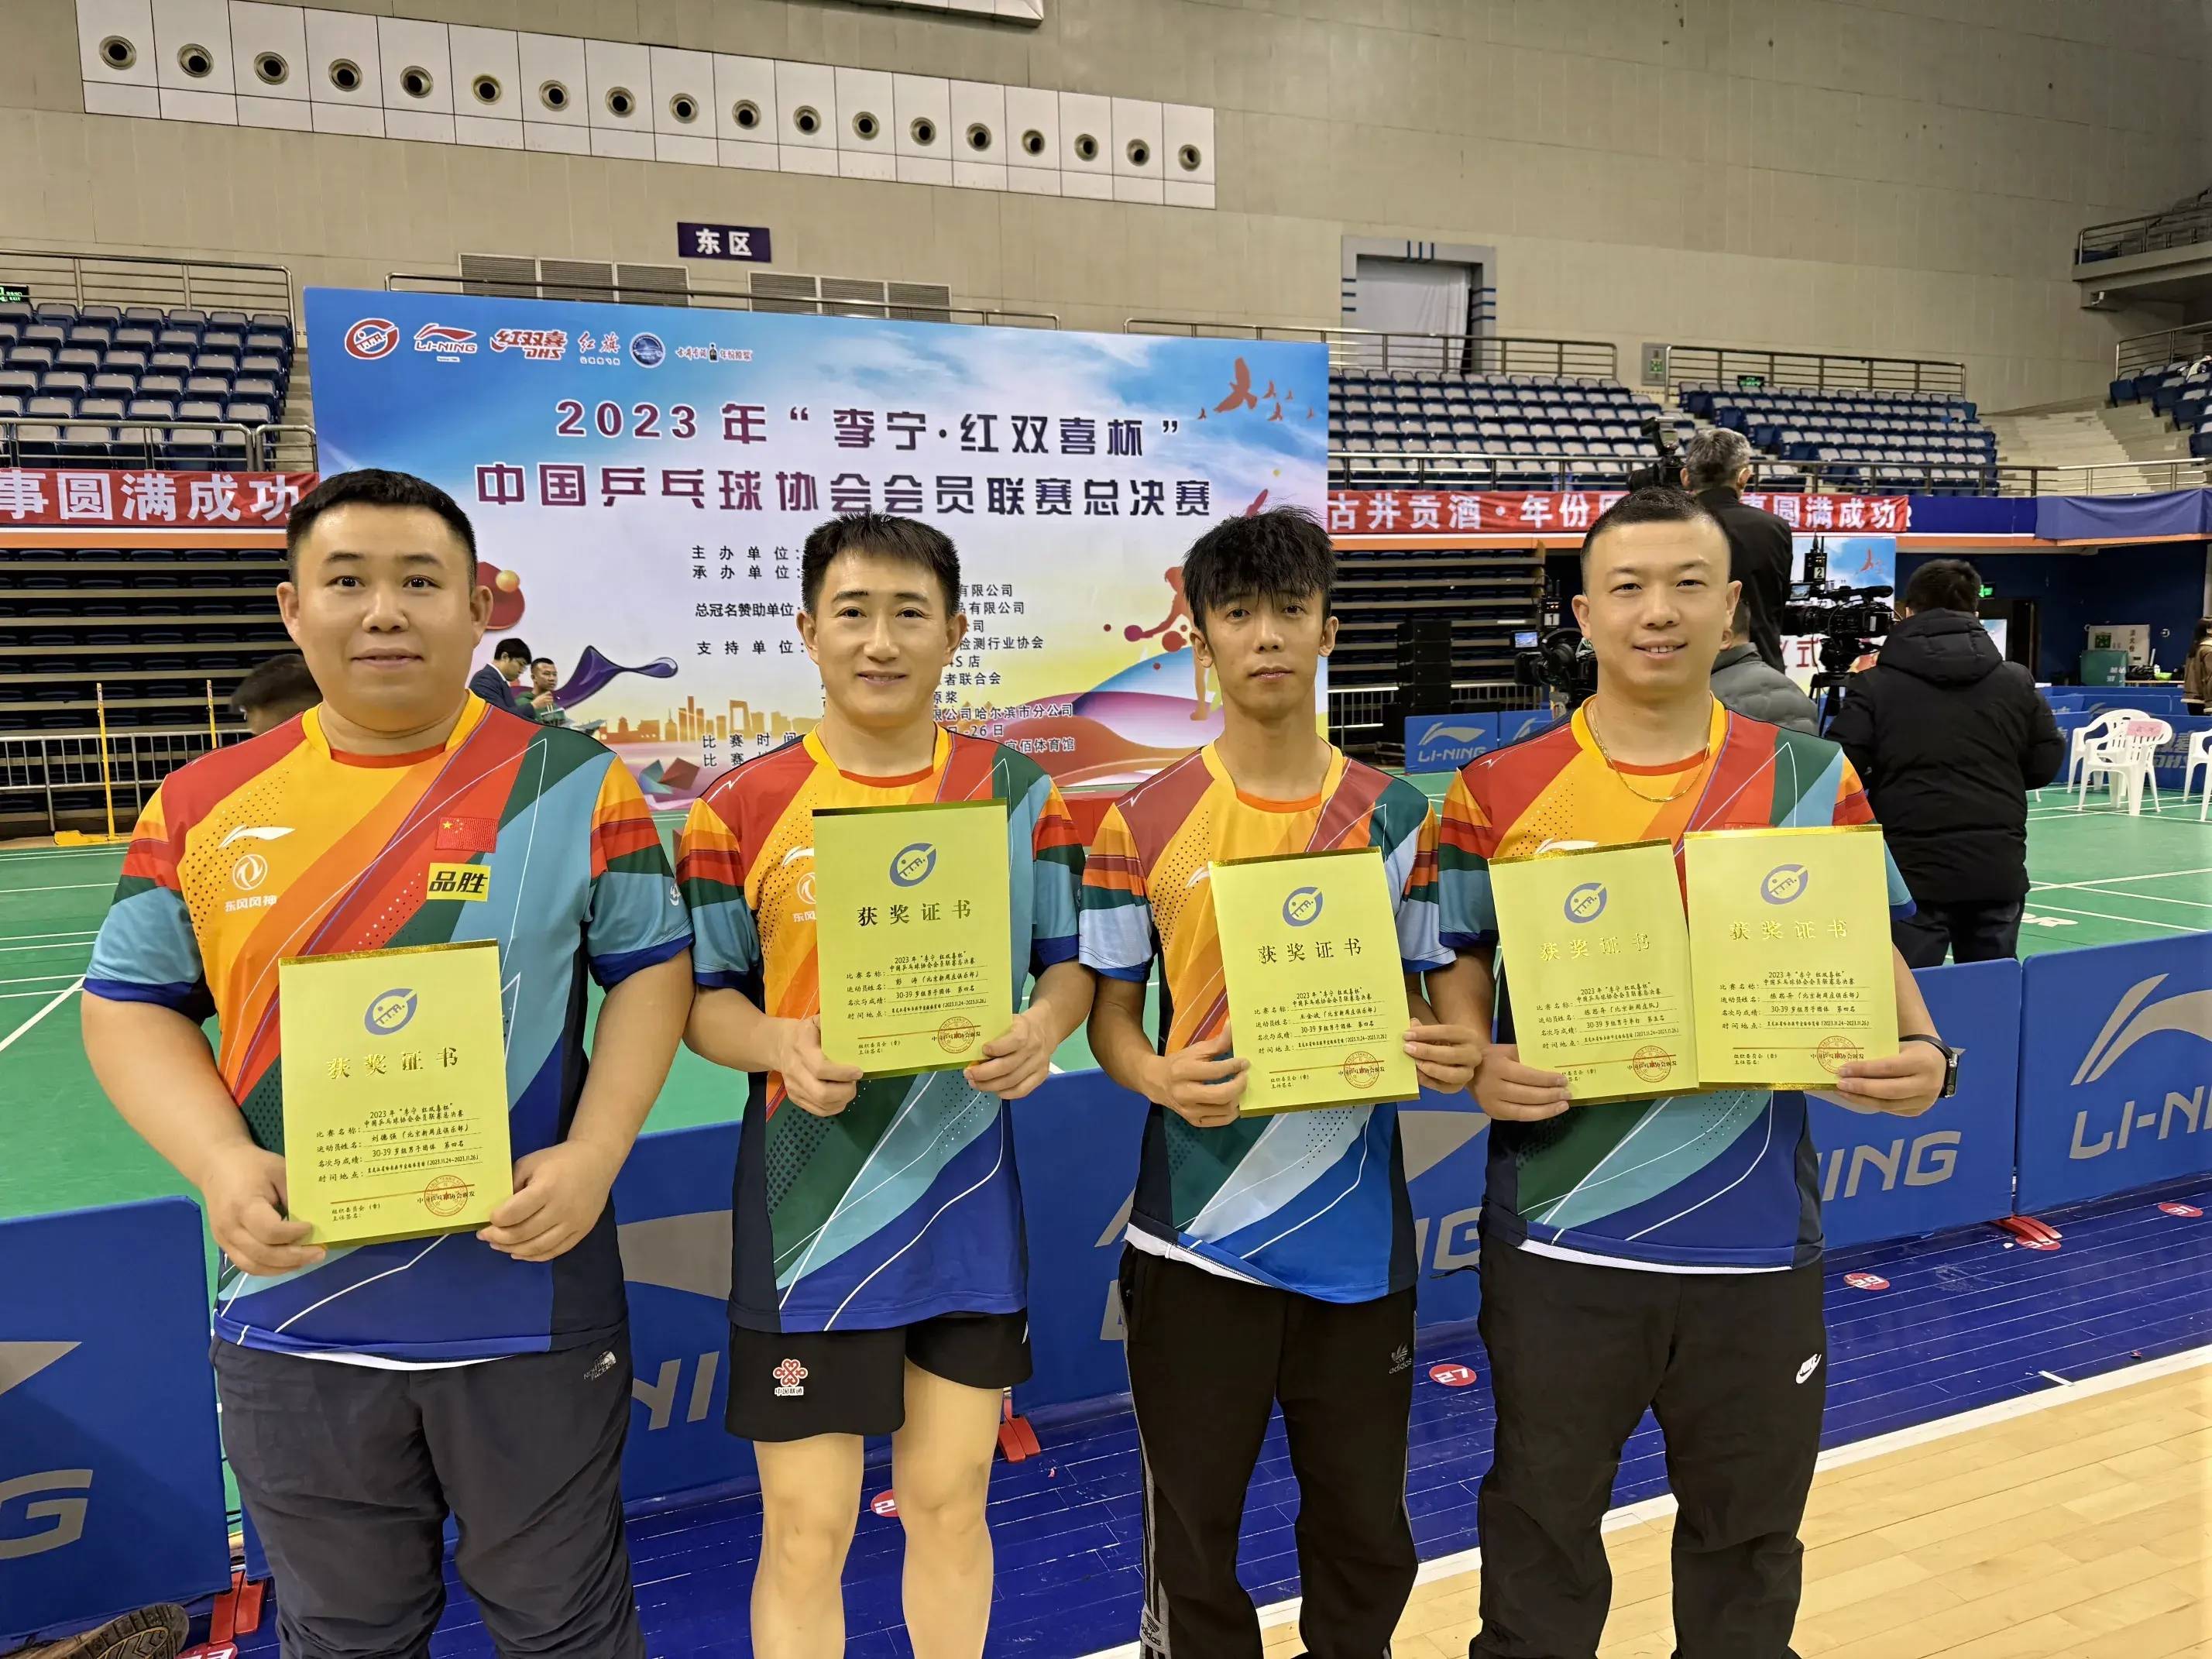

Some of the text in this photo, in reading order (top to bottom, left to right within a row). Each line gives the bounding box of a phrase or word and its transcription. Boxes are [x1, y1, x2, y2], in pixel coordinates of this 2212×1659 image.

[696, 228, 752, 256] 东区
[416, 342, 477, 352] LI-NING
[496, 329, 566, 348] 红双喜
[579, 332, 620, 353] 红旗
[525, 347, 562, 359] DHS
[0, 469, 300, 521] 事圆满成功
[476, 462, 1211, 517] 中国乒乓球协会会员联赛总决赛
[692, 545, 800, 561] 主办单位：
[692, 565, 801, 579] 承办单位：
[1817, 568, 1822, 578] 2
[696, 640, 804, 655] 支持单位：
[1417, 747, 1486, 762] LI-NING
[429, 871, 488, 894] 品胜
[225, 895, 277, 912] 东风风神
[857, 900, 971, 926] 获奖证书
[1729, 919, 1847, 940] 获奖证书
[1258, 938, 1362, 964] 获奖证书
[1539, 933, 1650, 961] 获奖证书
[327, 1047, 459, 1079] 获奖证书
[1389, 1358, 1412, 1374] adidas
[1434, 1368, 1468, 1383] 27
